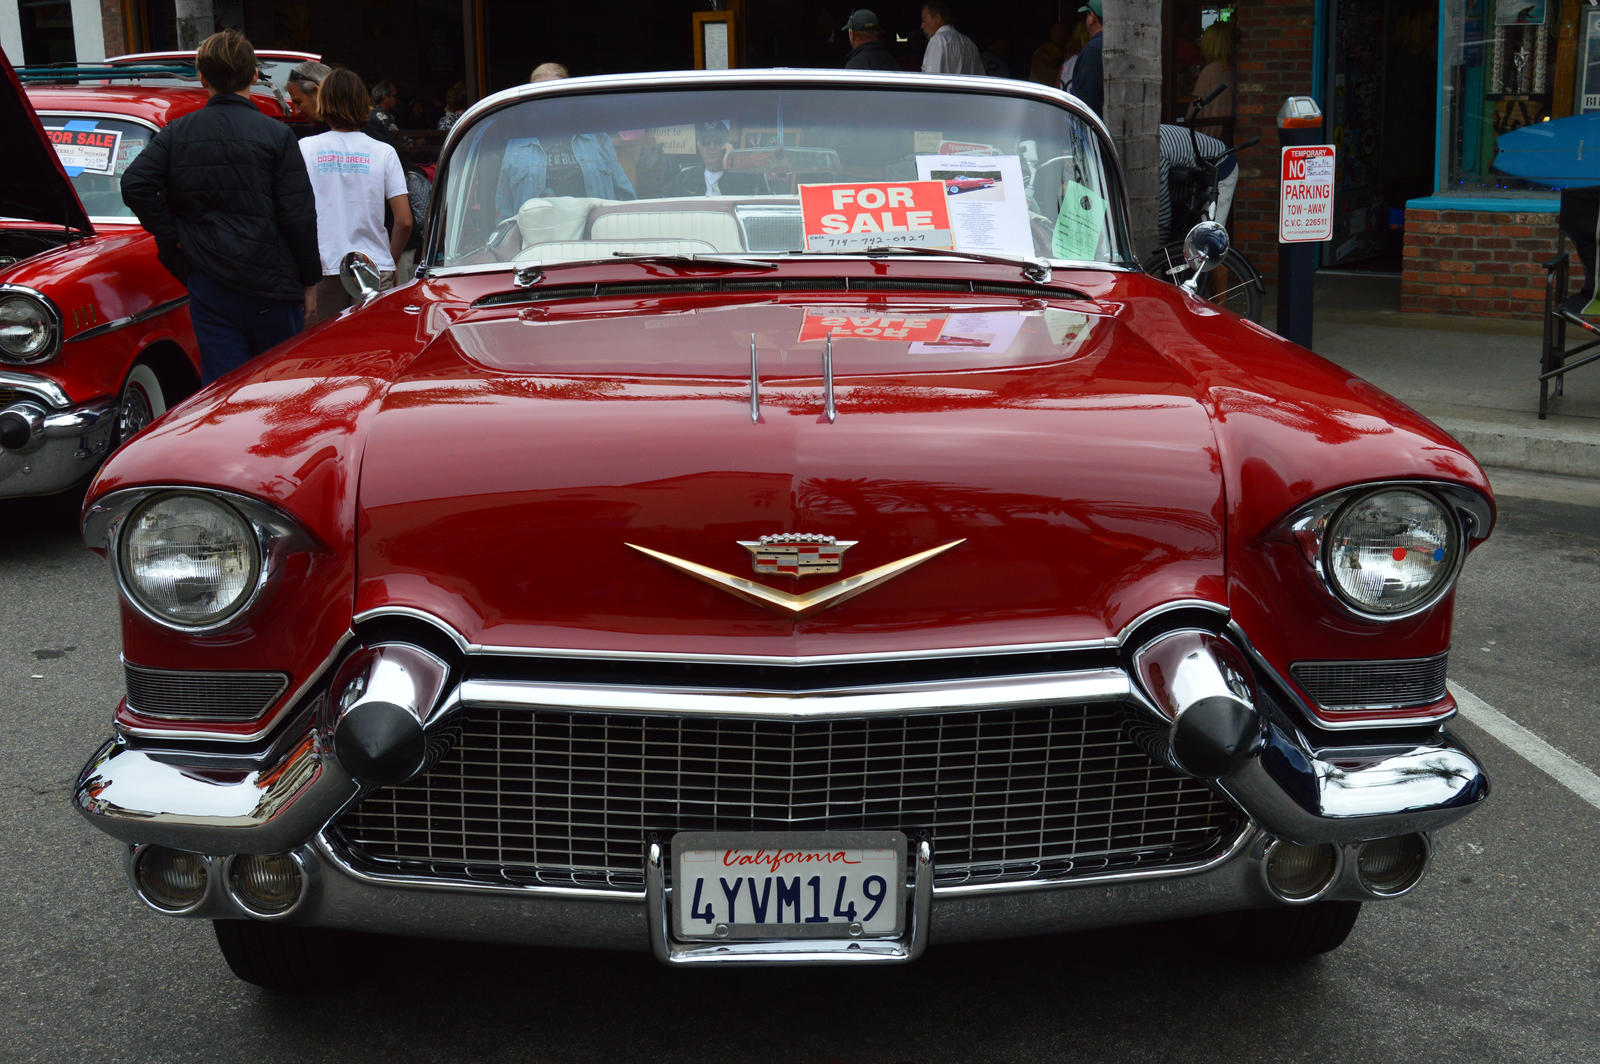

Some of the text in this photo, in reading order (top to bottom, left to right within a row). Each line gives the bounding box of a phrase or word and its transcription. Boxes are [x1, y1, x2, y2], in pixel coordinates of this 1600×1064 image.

[77, 132, 114, 147] SALE
[1291, 150, 1327, 158] TEMPORARY
[1289, 159, 1306, 178] NO
[832, 187, 915, 210] FOR
[1285, 184, 1330, 200] PARKING
[821, 211, 935, 234] SALE
[723, 849, 861, 873] California
[691, 875, 887, 924] 4YVM149
